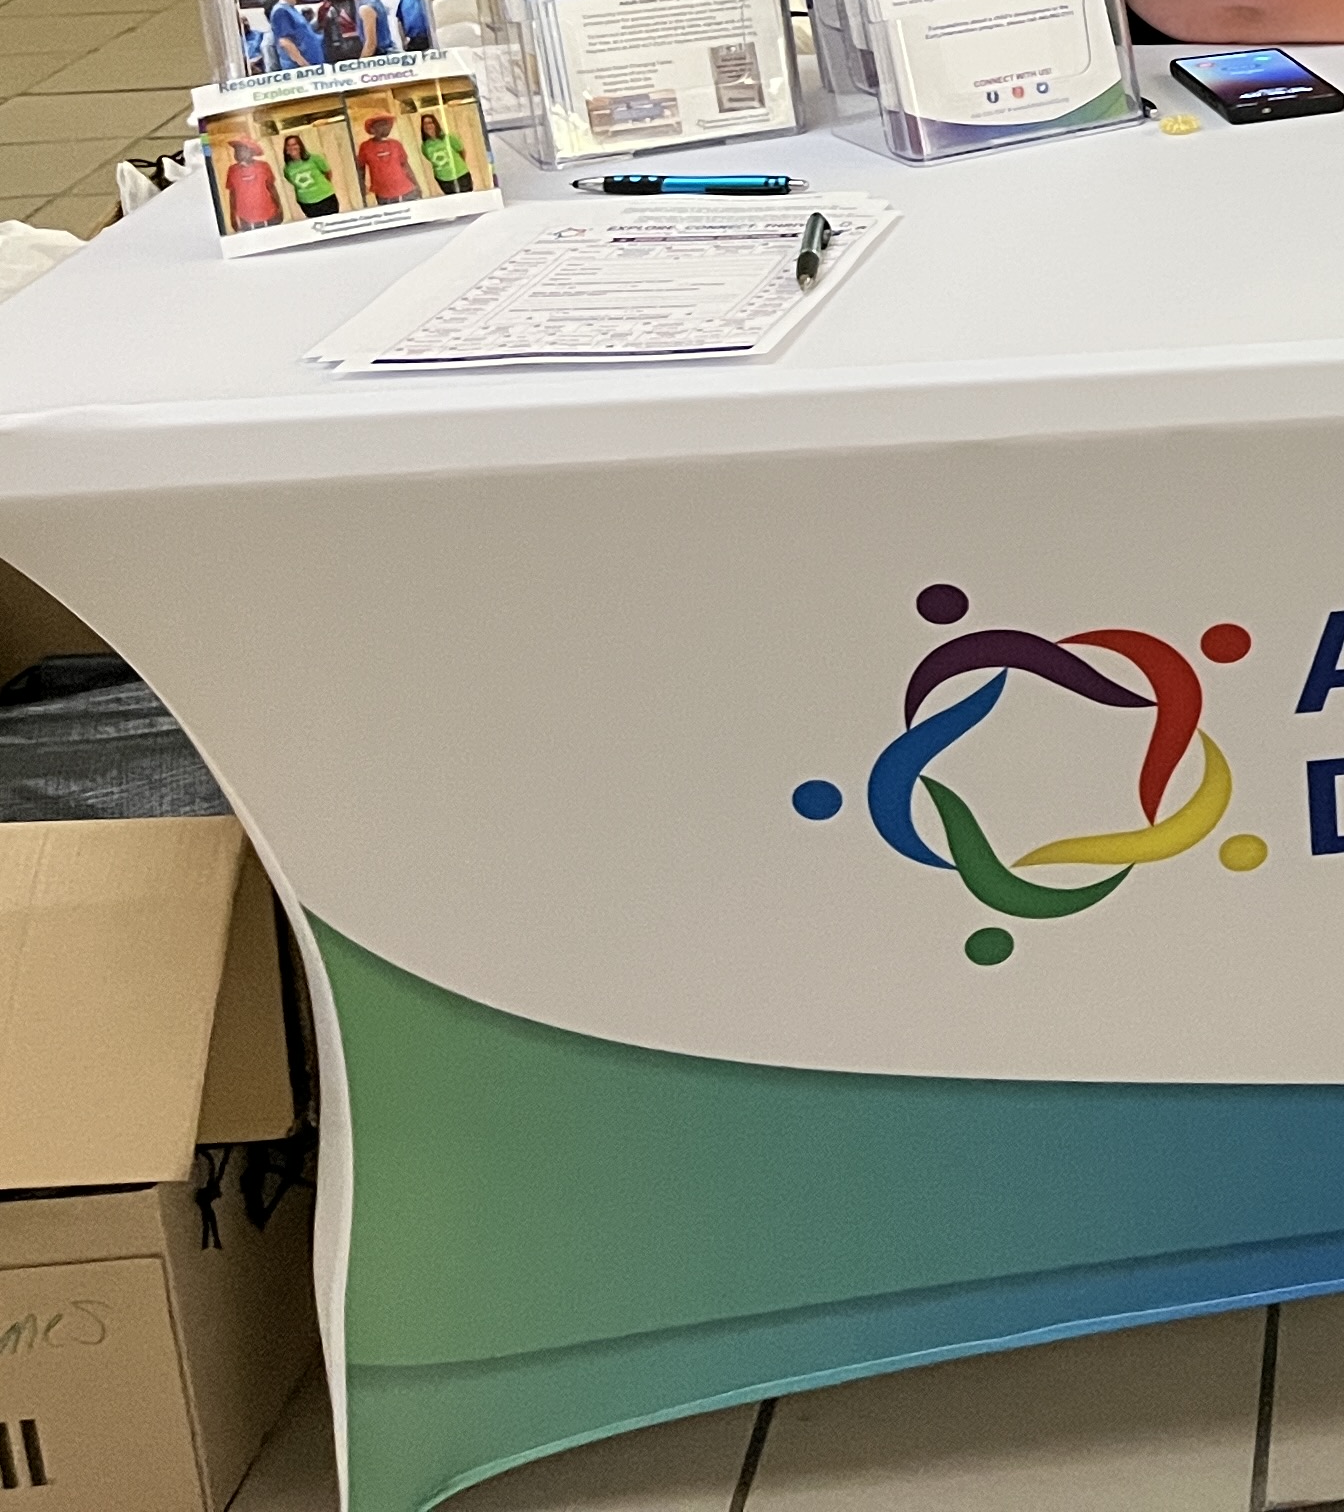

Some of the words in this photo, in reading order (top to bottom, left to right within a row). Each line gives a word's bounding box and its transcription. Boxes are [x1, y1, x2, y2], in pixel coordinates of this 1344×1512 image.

[218, 73, 291, 94] Resource
[296, 65, 325, 79] and
[330, 51, 417, 73] Technology
[421, 48, 448, 62] Fair
[252, 85, 308, 103] Explore.
[313, 78, 357, 92] Thrive.
[360, 67, 418, 85] Connect.
[973, 74, 1014, 88] CONNECT
